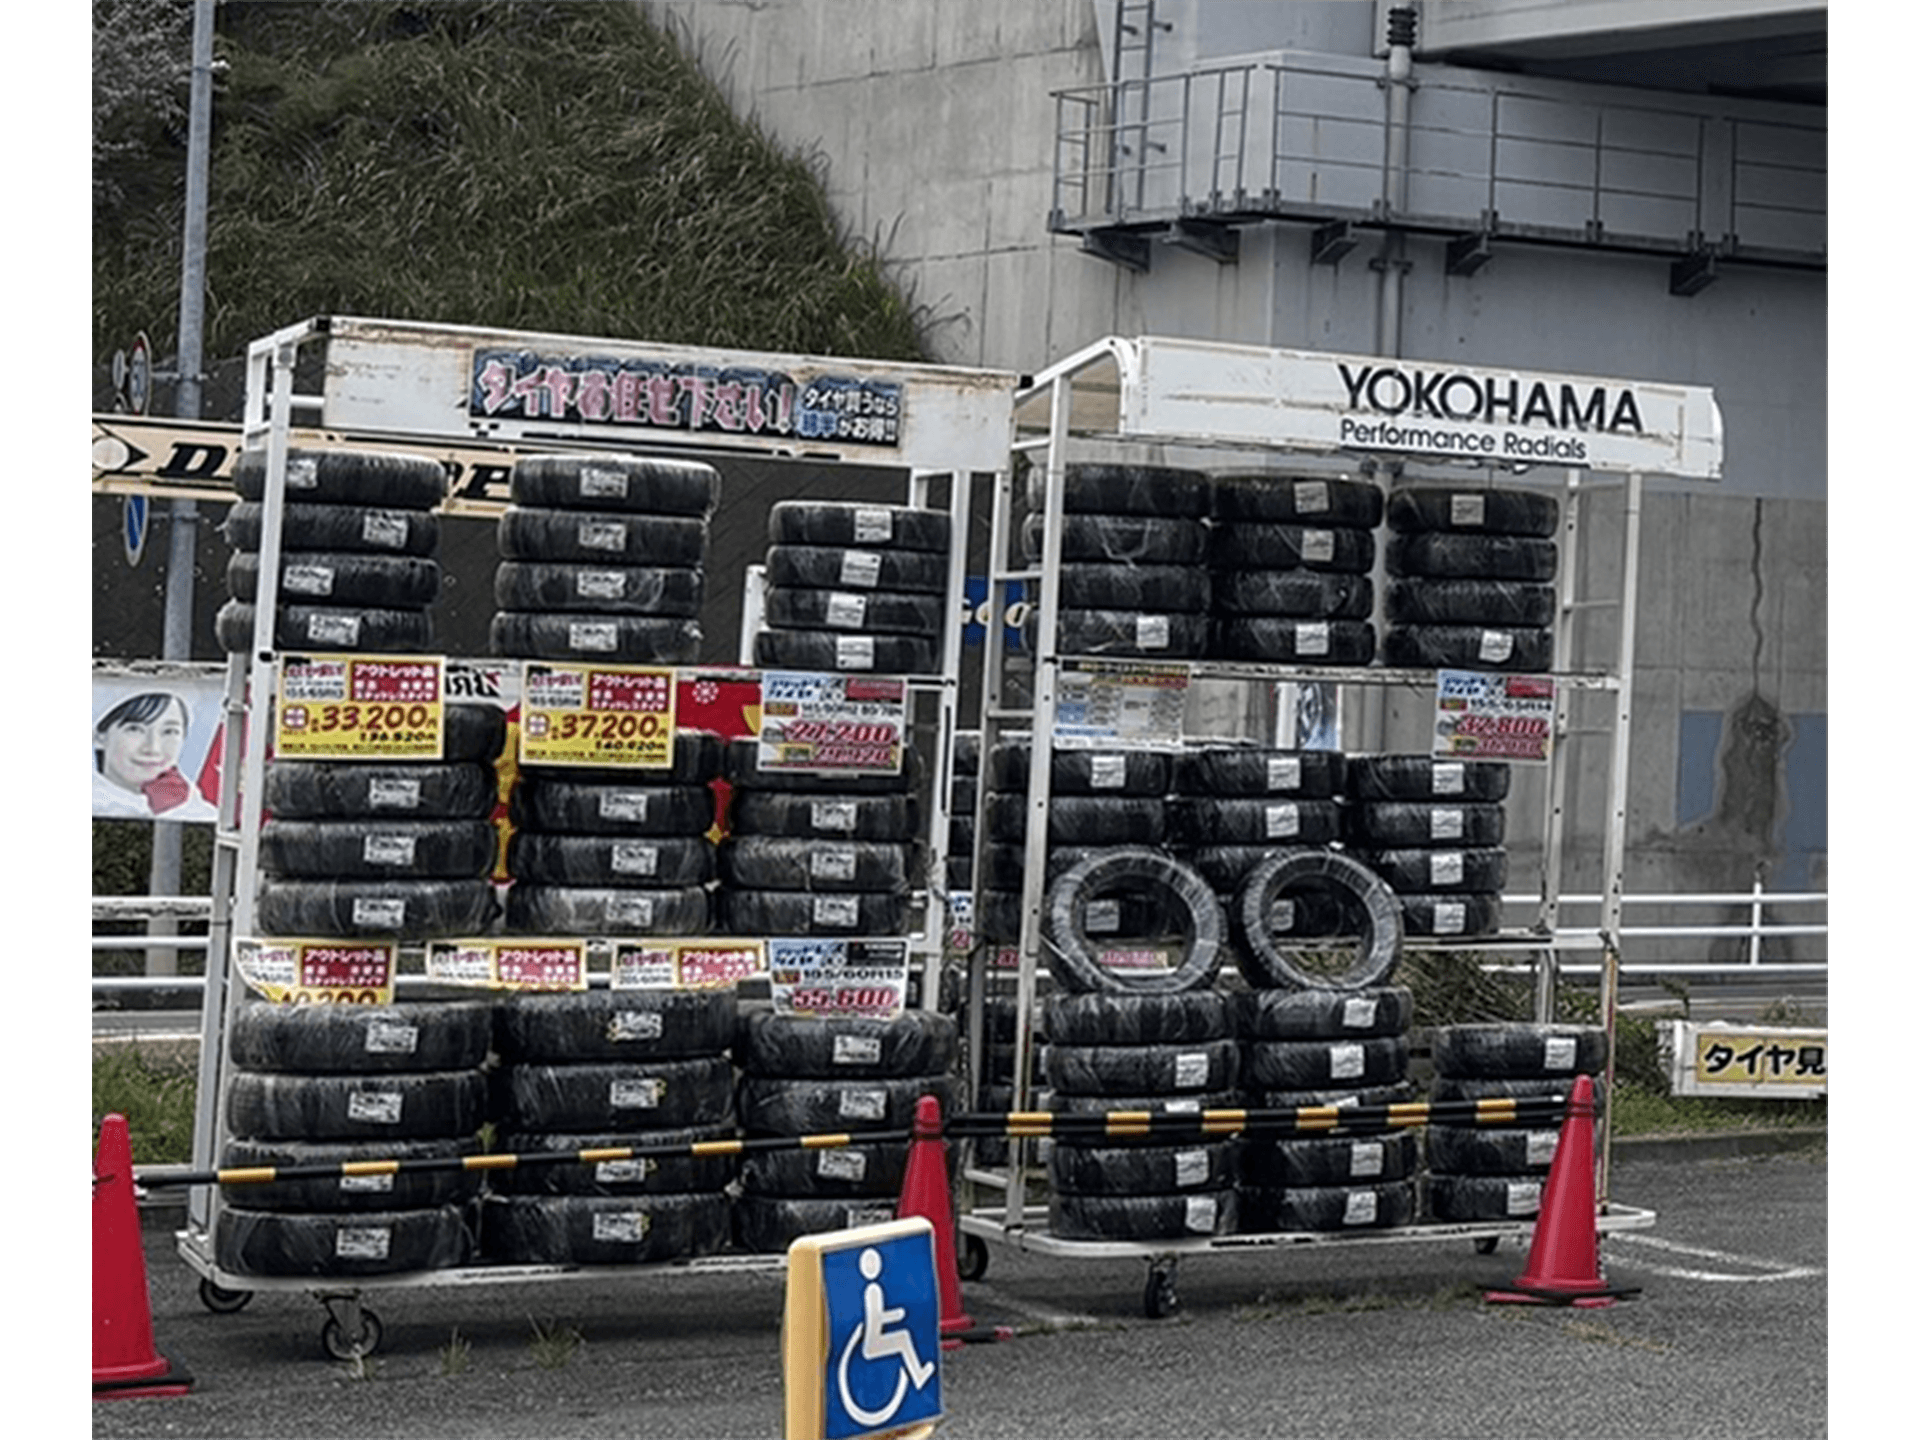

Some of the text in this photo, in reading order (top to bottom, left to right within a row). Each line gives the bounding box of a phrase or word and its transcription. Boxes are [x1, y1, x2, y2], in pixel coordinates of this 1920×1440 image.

[1337, 363, 1643, 434] YOKOHAMA
[1341, 419, 1587, 461] Performance Radials
[1704, 1043, 1826, 1076] タイヤ見
